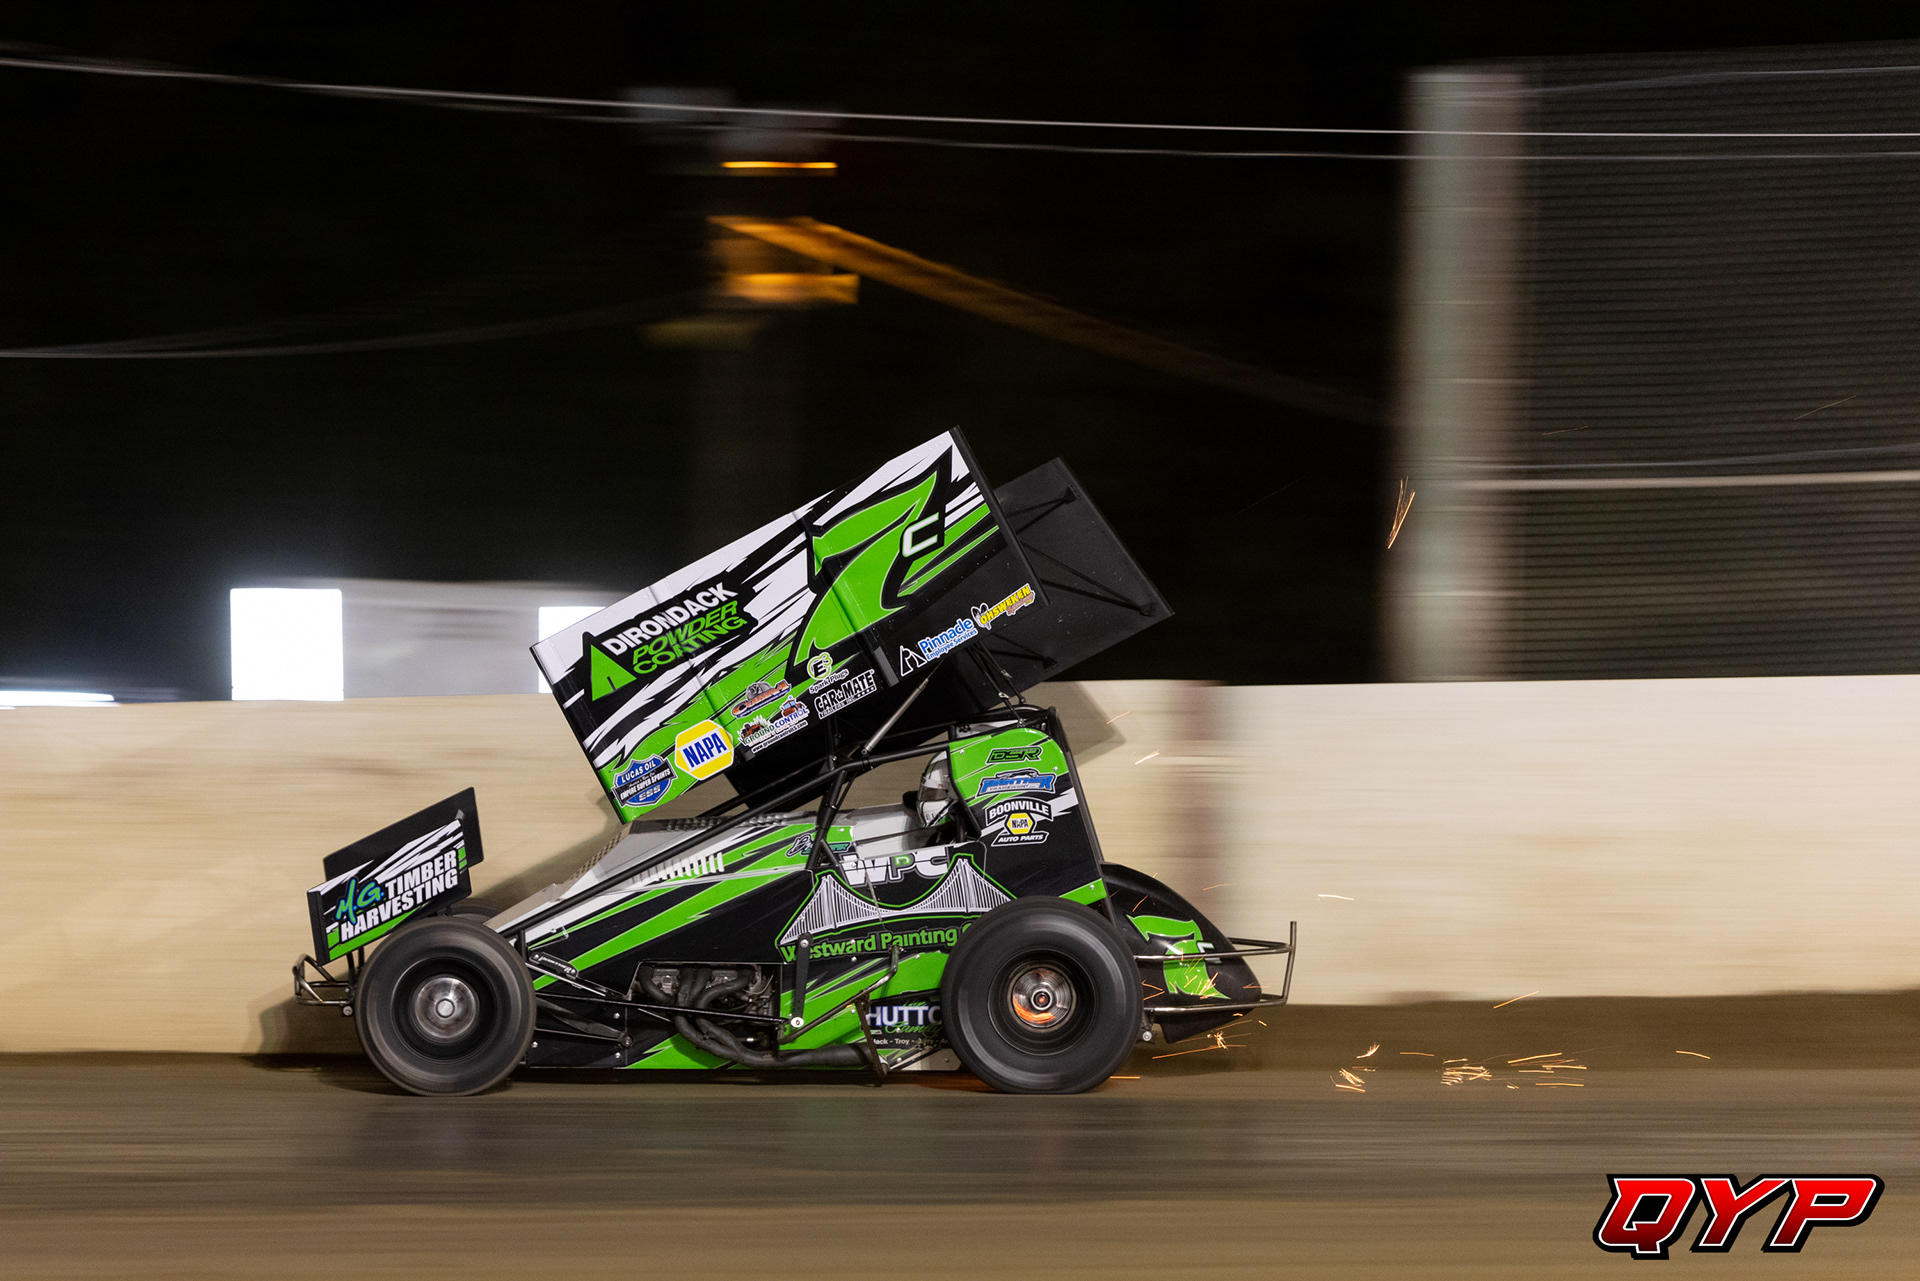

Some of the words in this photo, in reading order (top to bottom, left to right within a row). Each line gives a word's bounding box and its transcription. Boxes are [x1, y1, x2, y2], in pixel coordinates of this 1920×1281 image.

[794, 470, 938, 666] 7
[980, 585, 1031, 625] OHSWEKEN
[632, 600, 738, 665] POWDER
[633, 616, 748, 674] COATING
[919, 619, 974, 653] Pinnacle
[926, 642, 954, 660] Employee
[953, 629, 977, 645] Services
[809, 678, 829, 694] Spark
[829, 670, 849, 683] Plugs
[745, 725, 775, 744] GROUND
[774, 708, 808, 728] CONTROL
[682, 732, 728, 768] NAPA
[620, 784, 637, 800] EMPIRE
[637, 777, 652, 793] SUPER
[651, 768, 671, 785] SPRINTS
[621, 766, 643, 783] LUCAS
[644, 760, 657, 771] OIL
[989, 800, 1049, 820] BOONVILLE
[1011, 819, 1029, 829] NAPA
[998, 835, 1019, 843] AUTO
[1020, 834, 1044, 842] PARTS
[385, 850, 457, 899] TIMBER
[842, 846, 949, 886] WPC
[340, 868, 458, 942] HARVESTING
[780, 935, 876, 962] Wstward
[881, 928, 958, 951] Painting
[894, 1038, 910, 1048] Troy
